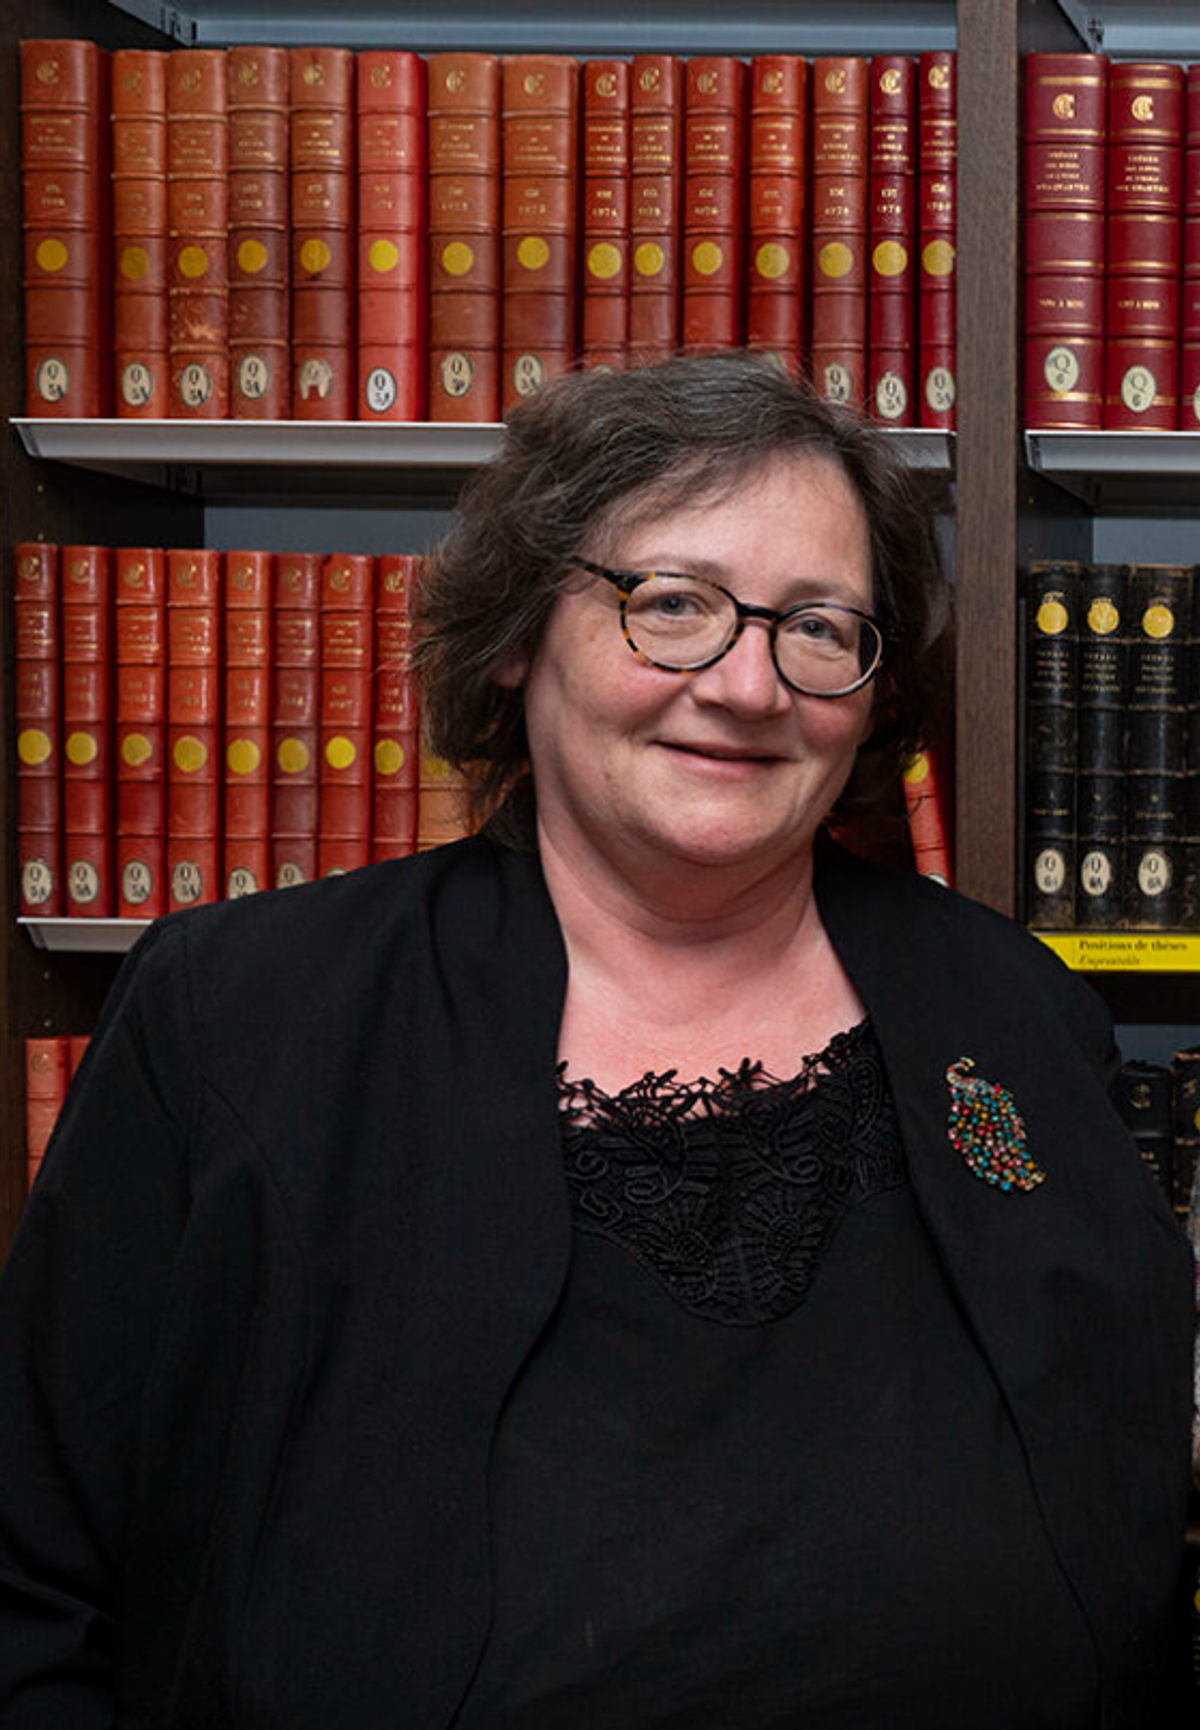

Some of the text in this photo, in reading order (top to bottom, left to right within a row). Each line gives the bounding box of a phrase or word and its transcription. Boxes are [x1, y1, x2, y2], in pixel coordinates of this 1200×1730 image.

[1054, 353, 1071, 374] Q
[1129, 374, 1147, 393] Q
[1079, 939, 1132, 950] Positions
[1134, 939, 1148, 950] de
